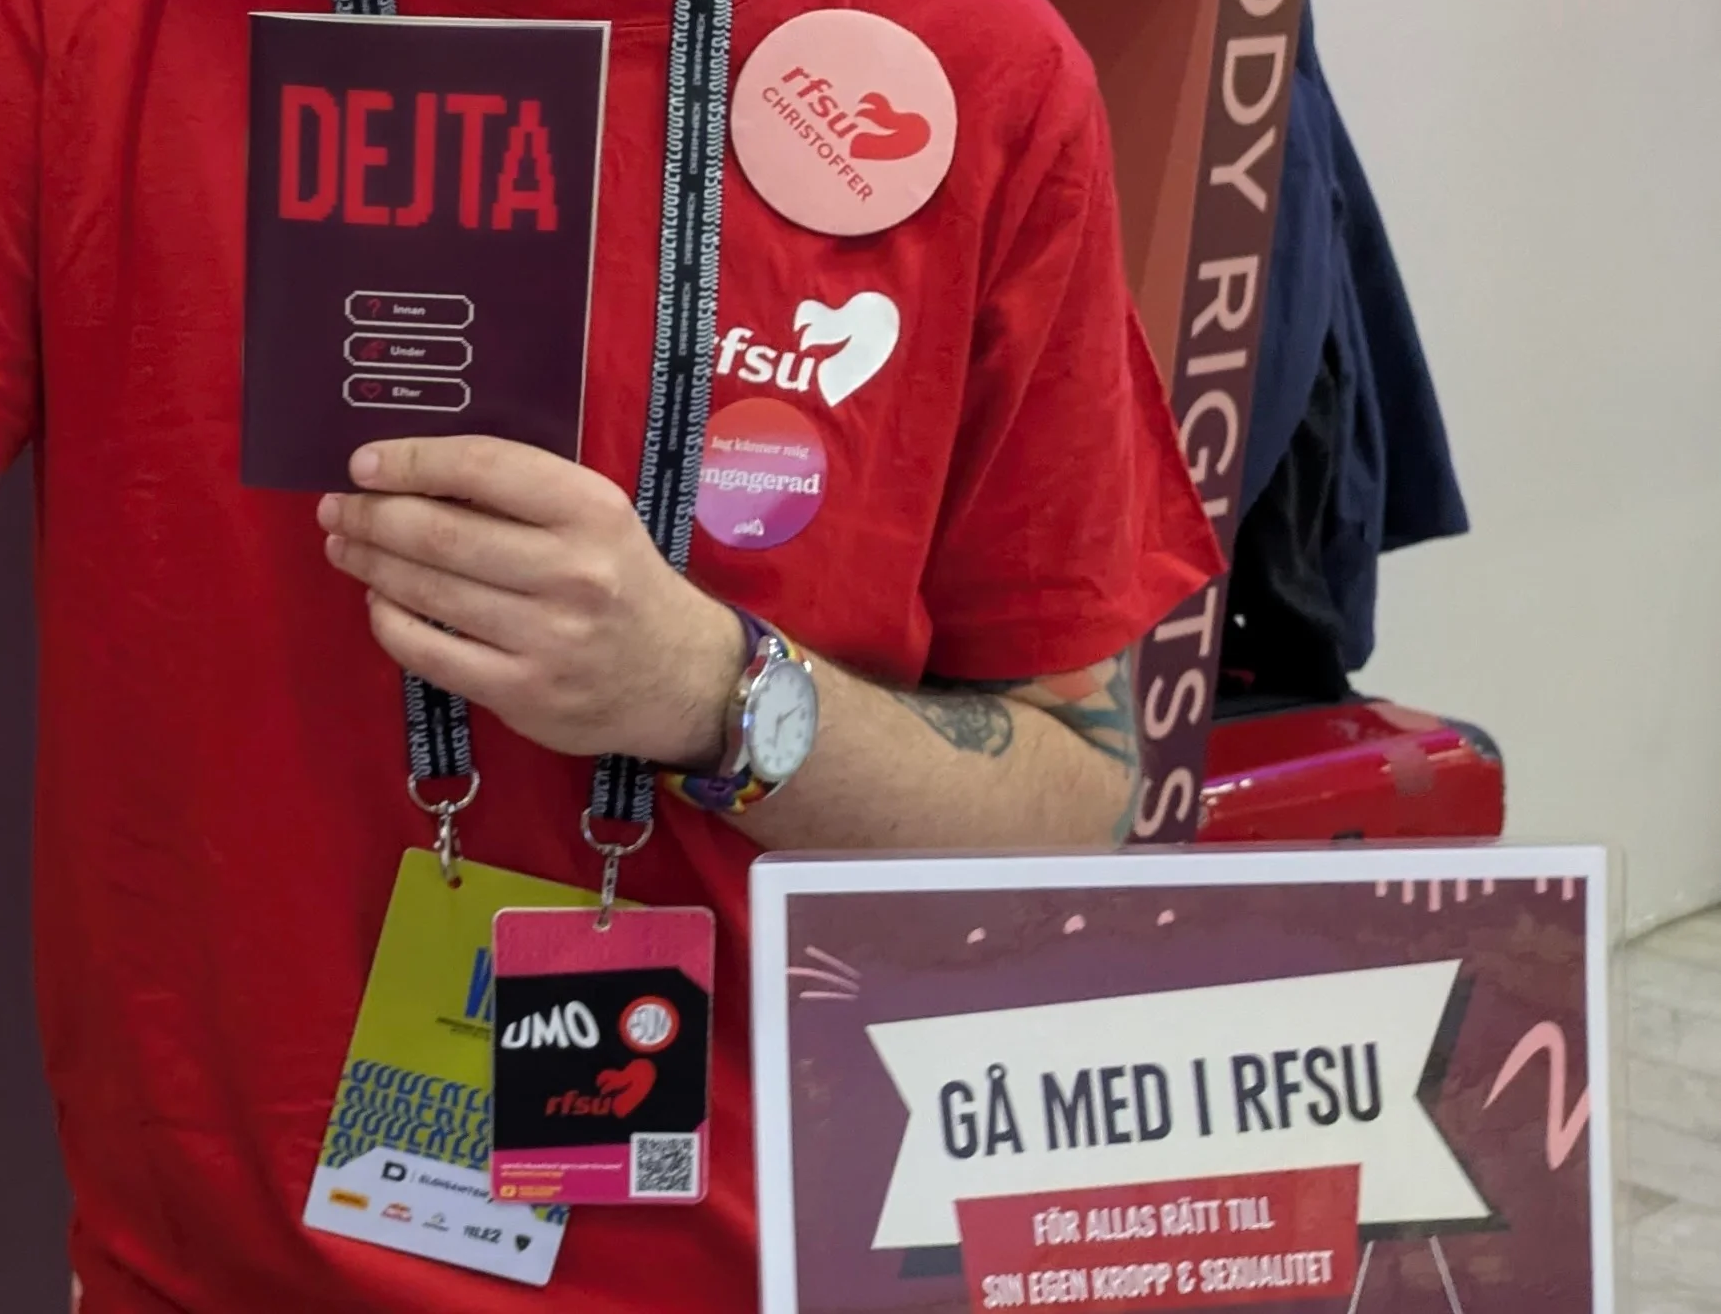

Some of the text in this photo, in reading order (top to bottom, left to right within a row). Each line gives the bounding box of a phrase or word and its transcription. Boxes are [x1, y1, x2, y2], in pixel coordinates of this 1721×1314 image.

[781, 65, 859, 140] rfsu
[279, 83, 559, 232] DEJTA
[761, 86, 874, 203] CHRISTOFFER
[392, 303, 427, 316] Innan
[390, 345, 427, 357] Under
[391, 386, 423, 398] Efter
[500, 999, 601, 1050] UMO
[544, 1088, 612, 1118] rfsu
[938, 1041, 1384, 1161] GÅ MED I RFSU
[1031, 1195, 1276, 1247] FÖR ALLAS RÄTT TILL
[981, 1249, 1335, 1310] SIN EGEN KROPP & SEXUALITET
